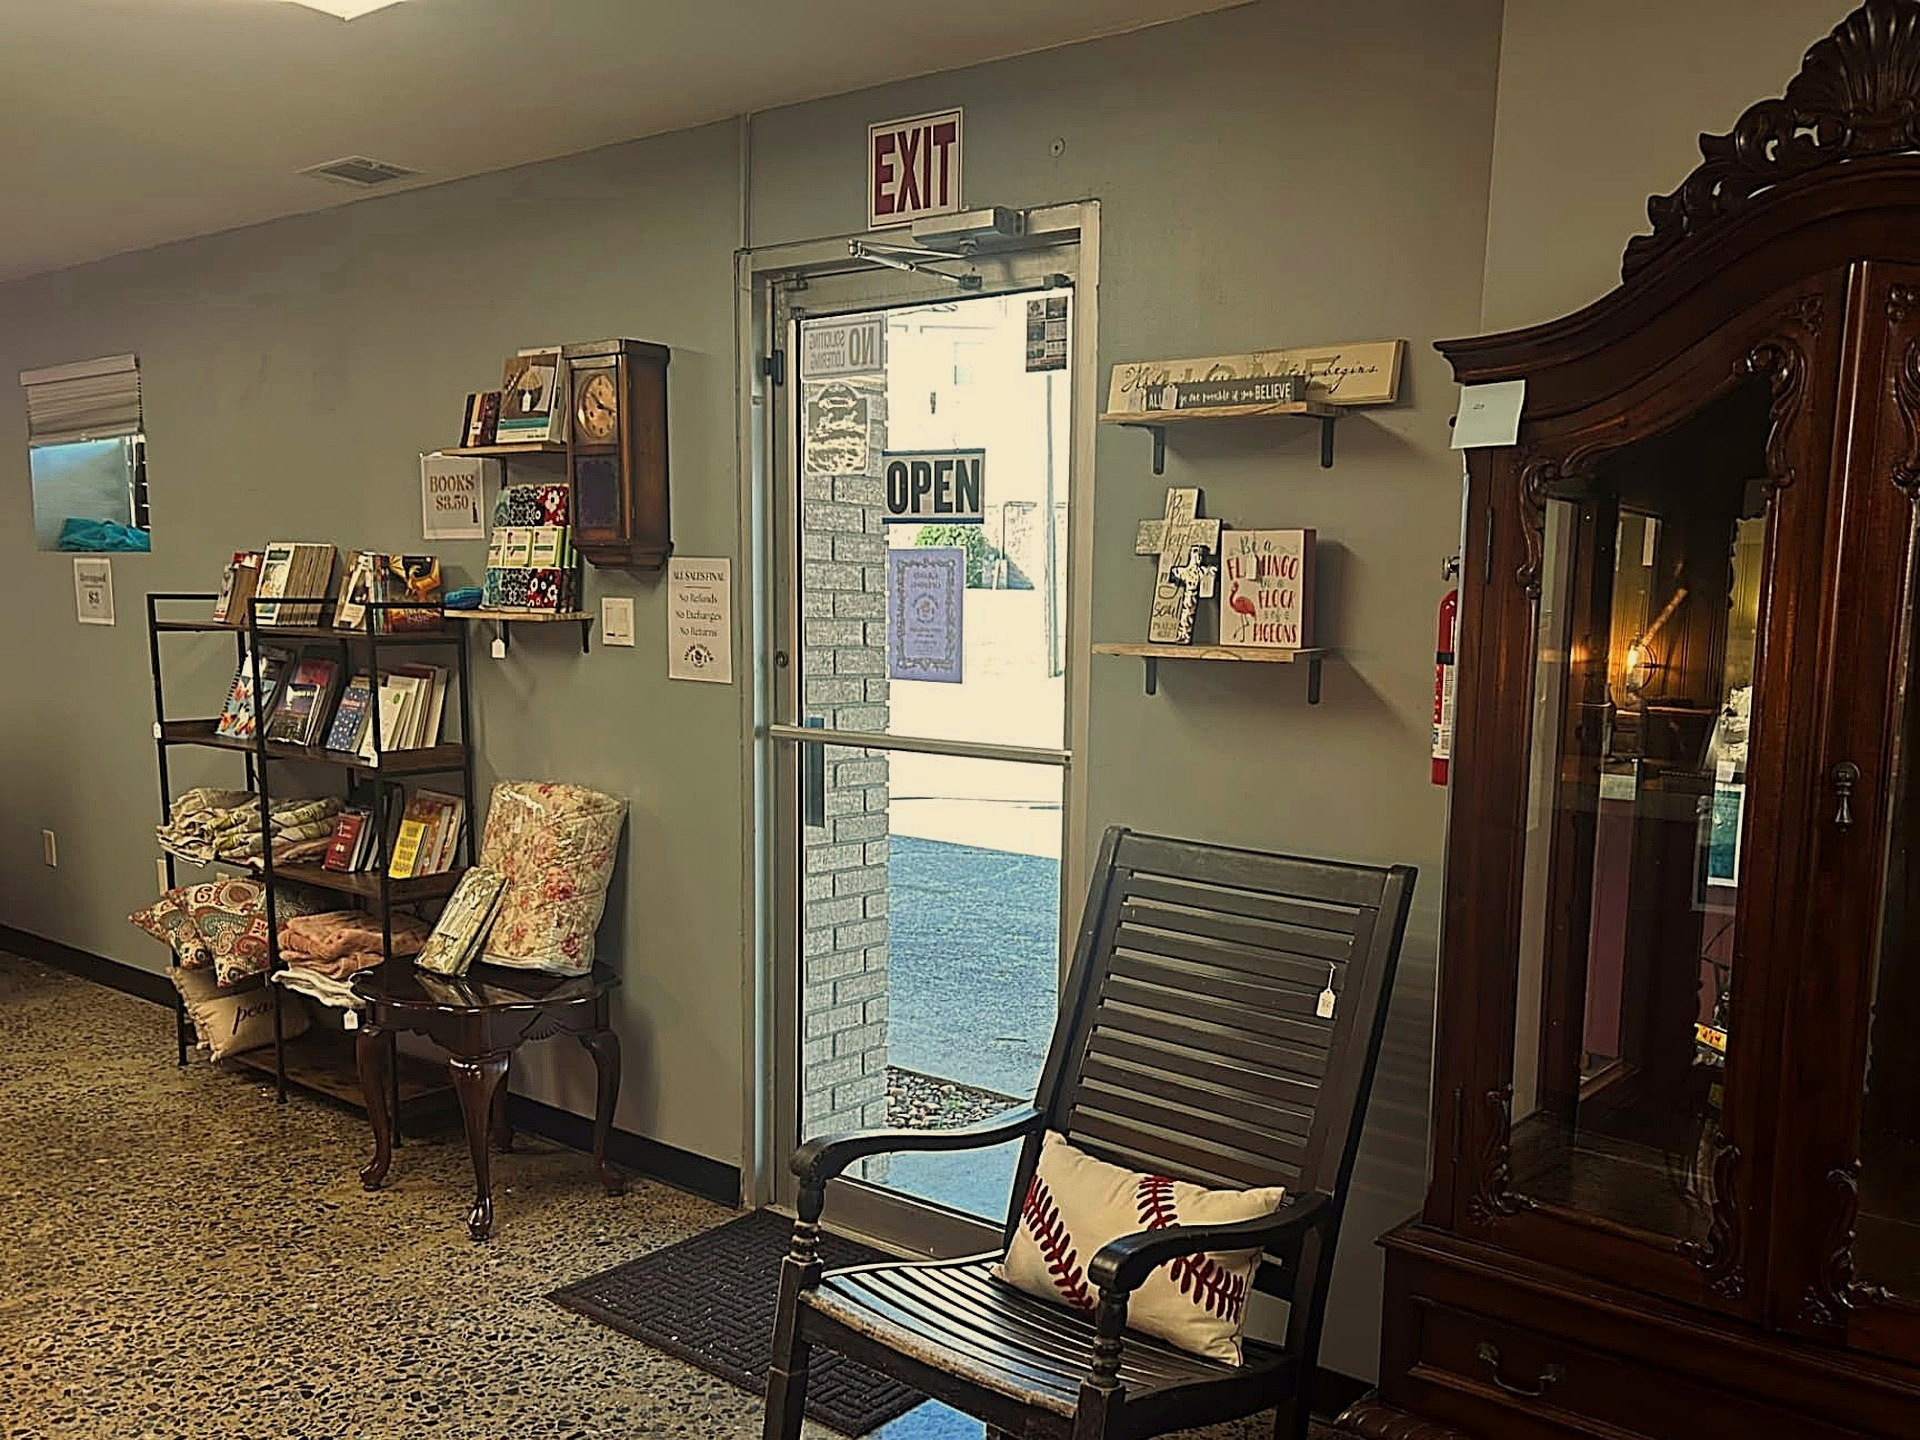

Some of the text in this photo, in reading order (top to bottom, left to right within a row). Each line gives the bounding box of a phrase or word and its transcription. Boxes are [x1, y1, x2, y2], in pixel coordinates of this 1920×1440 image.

[875, 122, 956, 215] EXIT
[1254, 382, 1292, 401] BELIEVE
[430, 474, 475, 492] BOOKS
[887, 459, 980, 515] OPEN
[436, 494, 469, 511] $3.50
[1240, 535, 1273, 555] Be a
[1226, 554, 1299, 580] FLMINGO
[679, 594, 689, 602] No
[1258, 589, 1296, 609] FLOCK
[675, 610, 685, 619] No
[680, 627, 689, 636] No
[1253, 622, 1297, 643] PIGEONS
